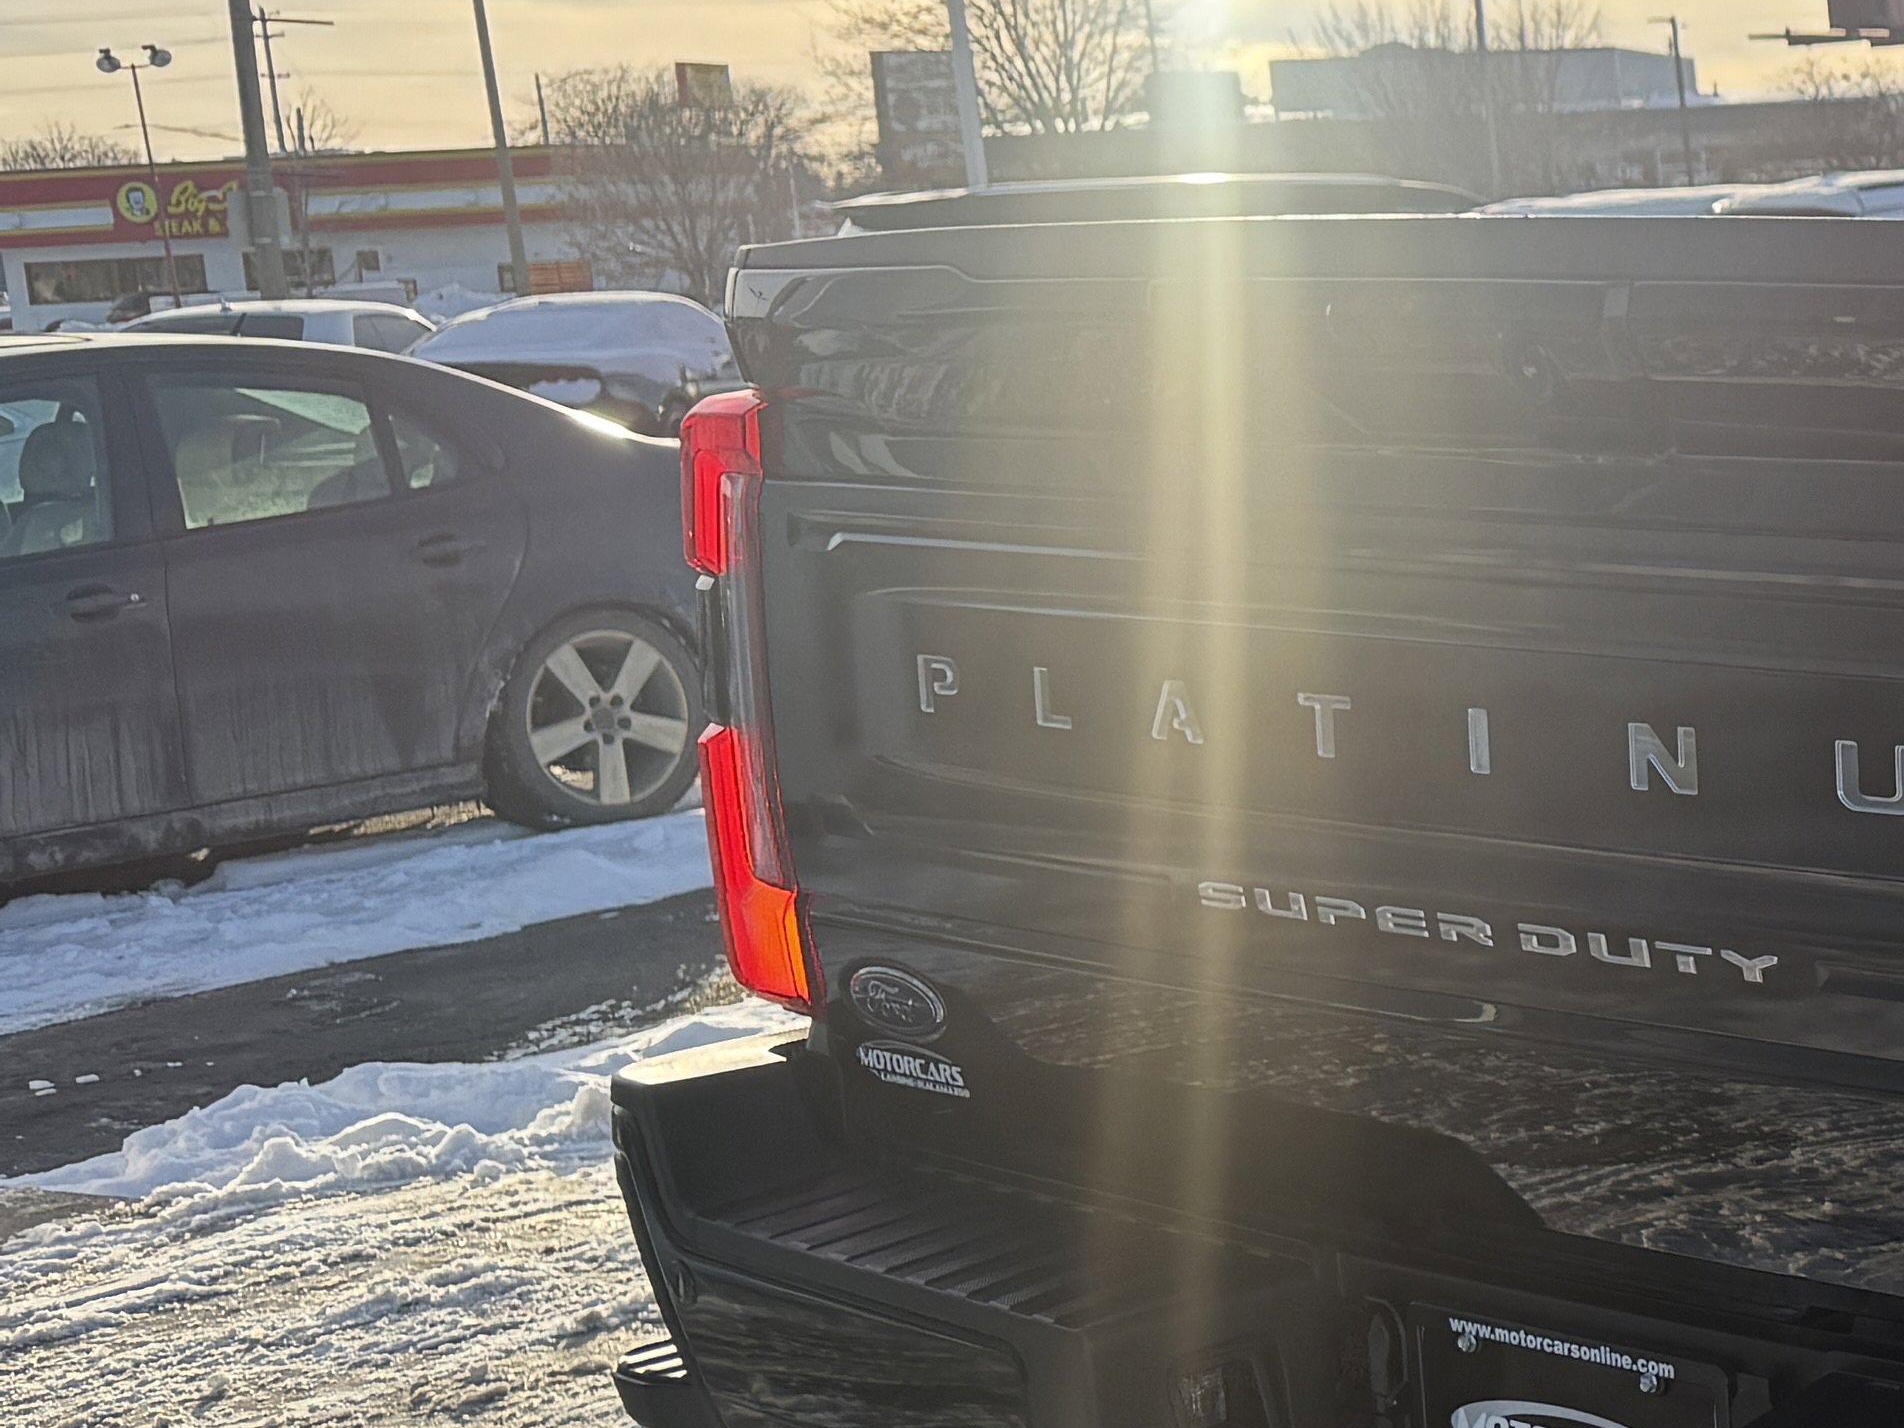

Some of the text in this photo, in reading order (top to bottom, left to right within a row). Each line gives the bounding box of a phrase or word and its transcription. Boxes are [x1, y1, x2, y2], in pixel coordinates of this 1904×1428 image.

[1196, 880, 1780, 984] SUPER DUTY
[858, 1046, 965, 1087] MOTORCARS
[1448, 1316, 1676, 1380] www.motorcarsonline.com
